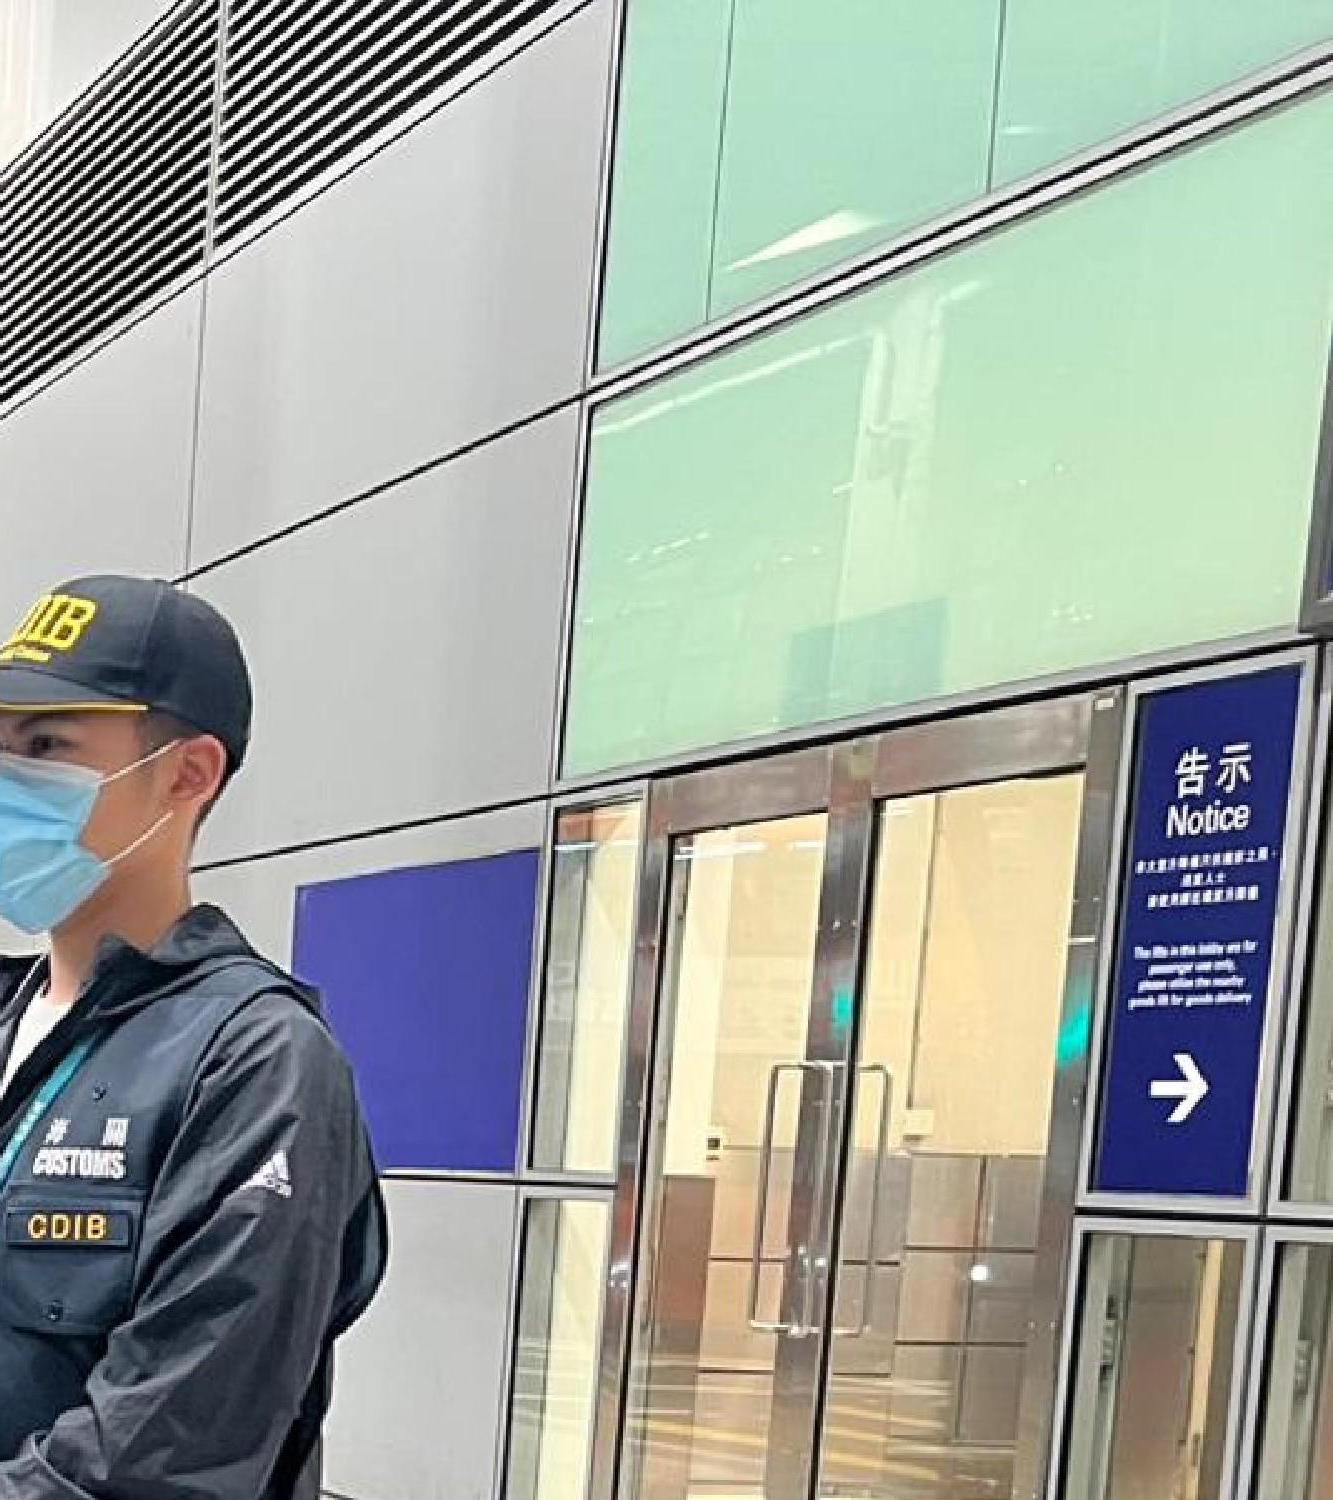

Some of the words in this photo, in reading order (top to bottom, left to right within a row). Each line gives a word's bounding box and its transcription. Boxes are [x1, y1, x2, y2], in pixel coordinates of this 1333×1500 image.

[1175, 742, 1252, 798] 告示
[1166, 800, 1251, 838] Notice
[32, 1147, 126, 1178] CUSTOMS
[28, 1214, 107, 1240] CDIB
